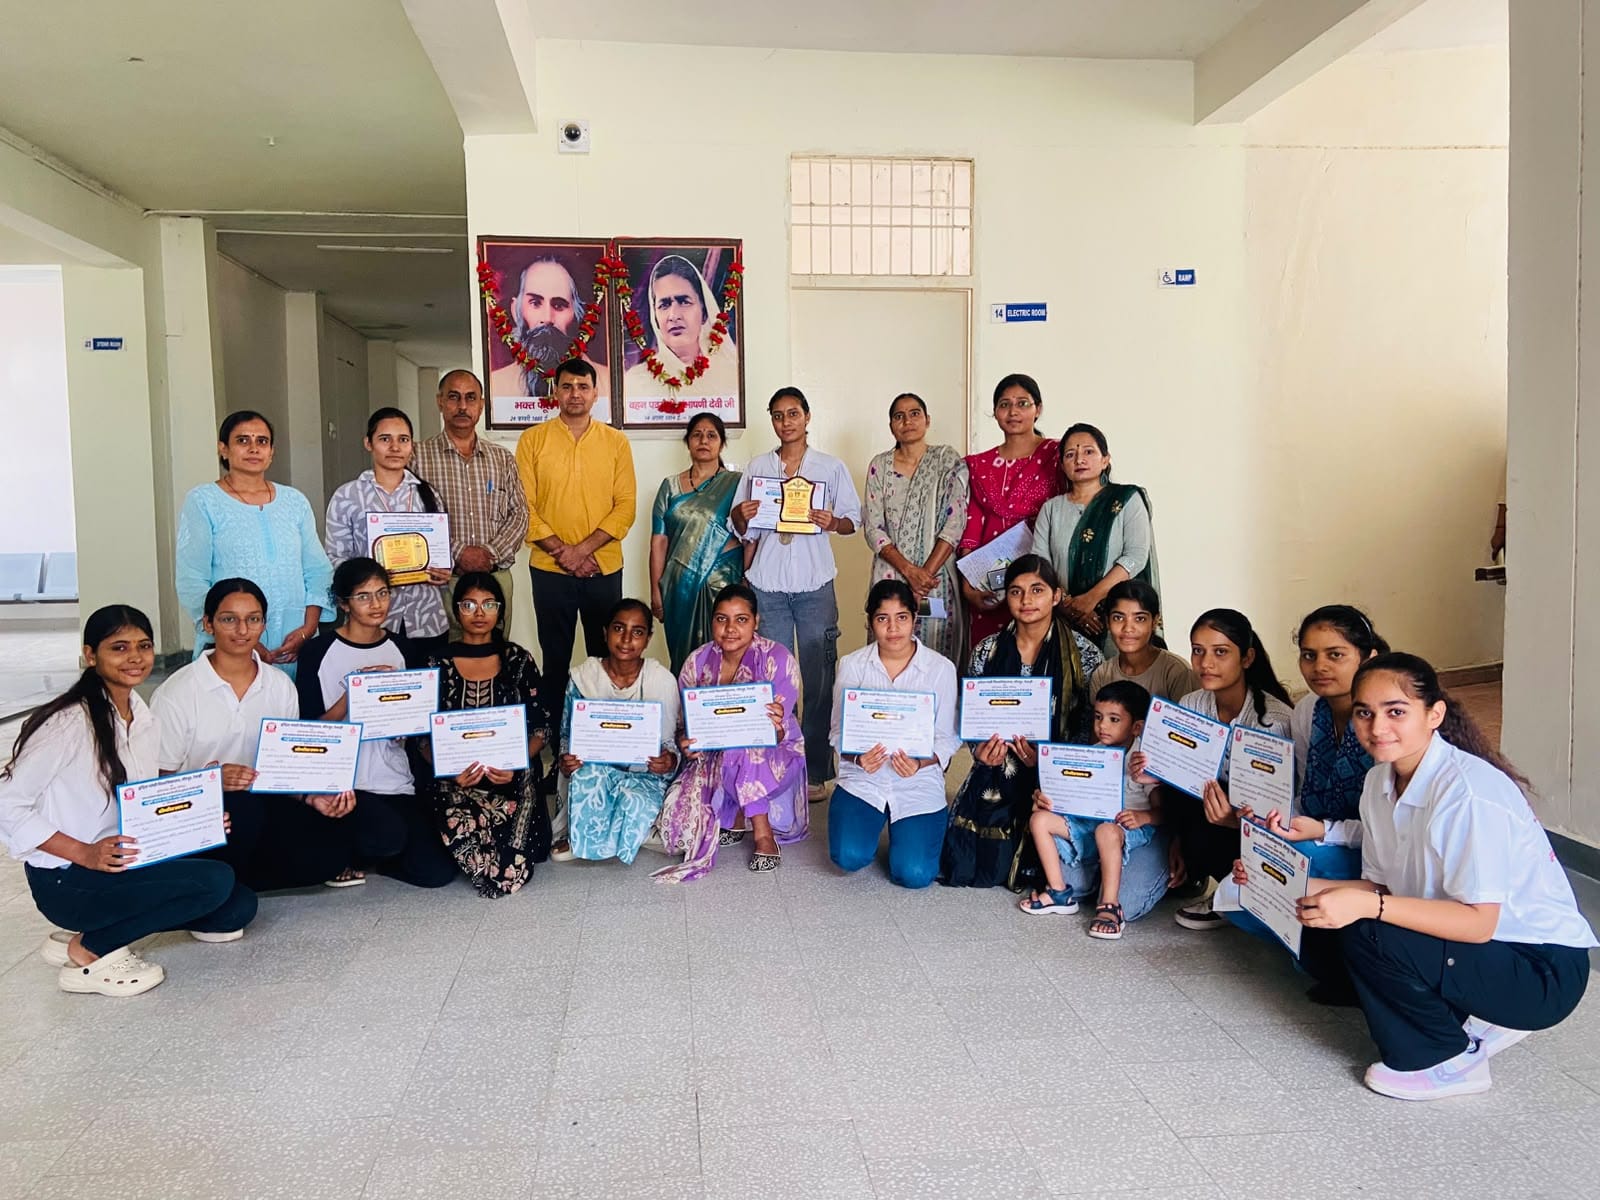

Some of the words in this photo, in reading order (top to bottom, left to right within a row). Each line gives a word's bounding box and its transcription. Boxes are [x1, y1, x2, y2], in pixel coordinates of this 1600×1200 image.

[995, 308, 1003, 318] 14
[1007, 309, 1031, 317] ELECTRIC
[1031, 308, 1046, 317] ROOM
[514, 400, 535, 410] भक्त
[709, 397, 723, 409] देवी
[725, 397, 735, 409] जी
